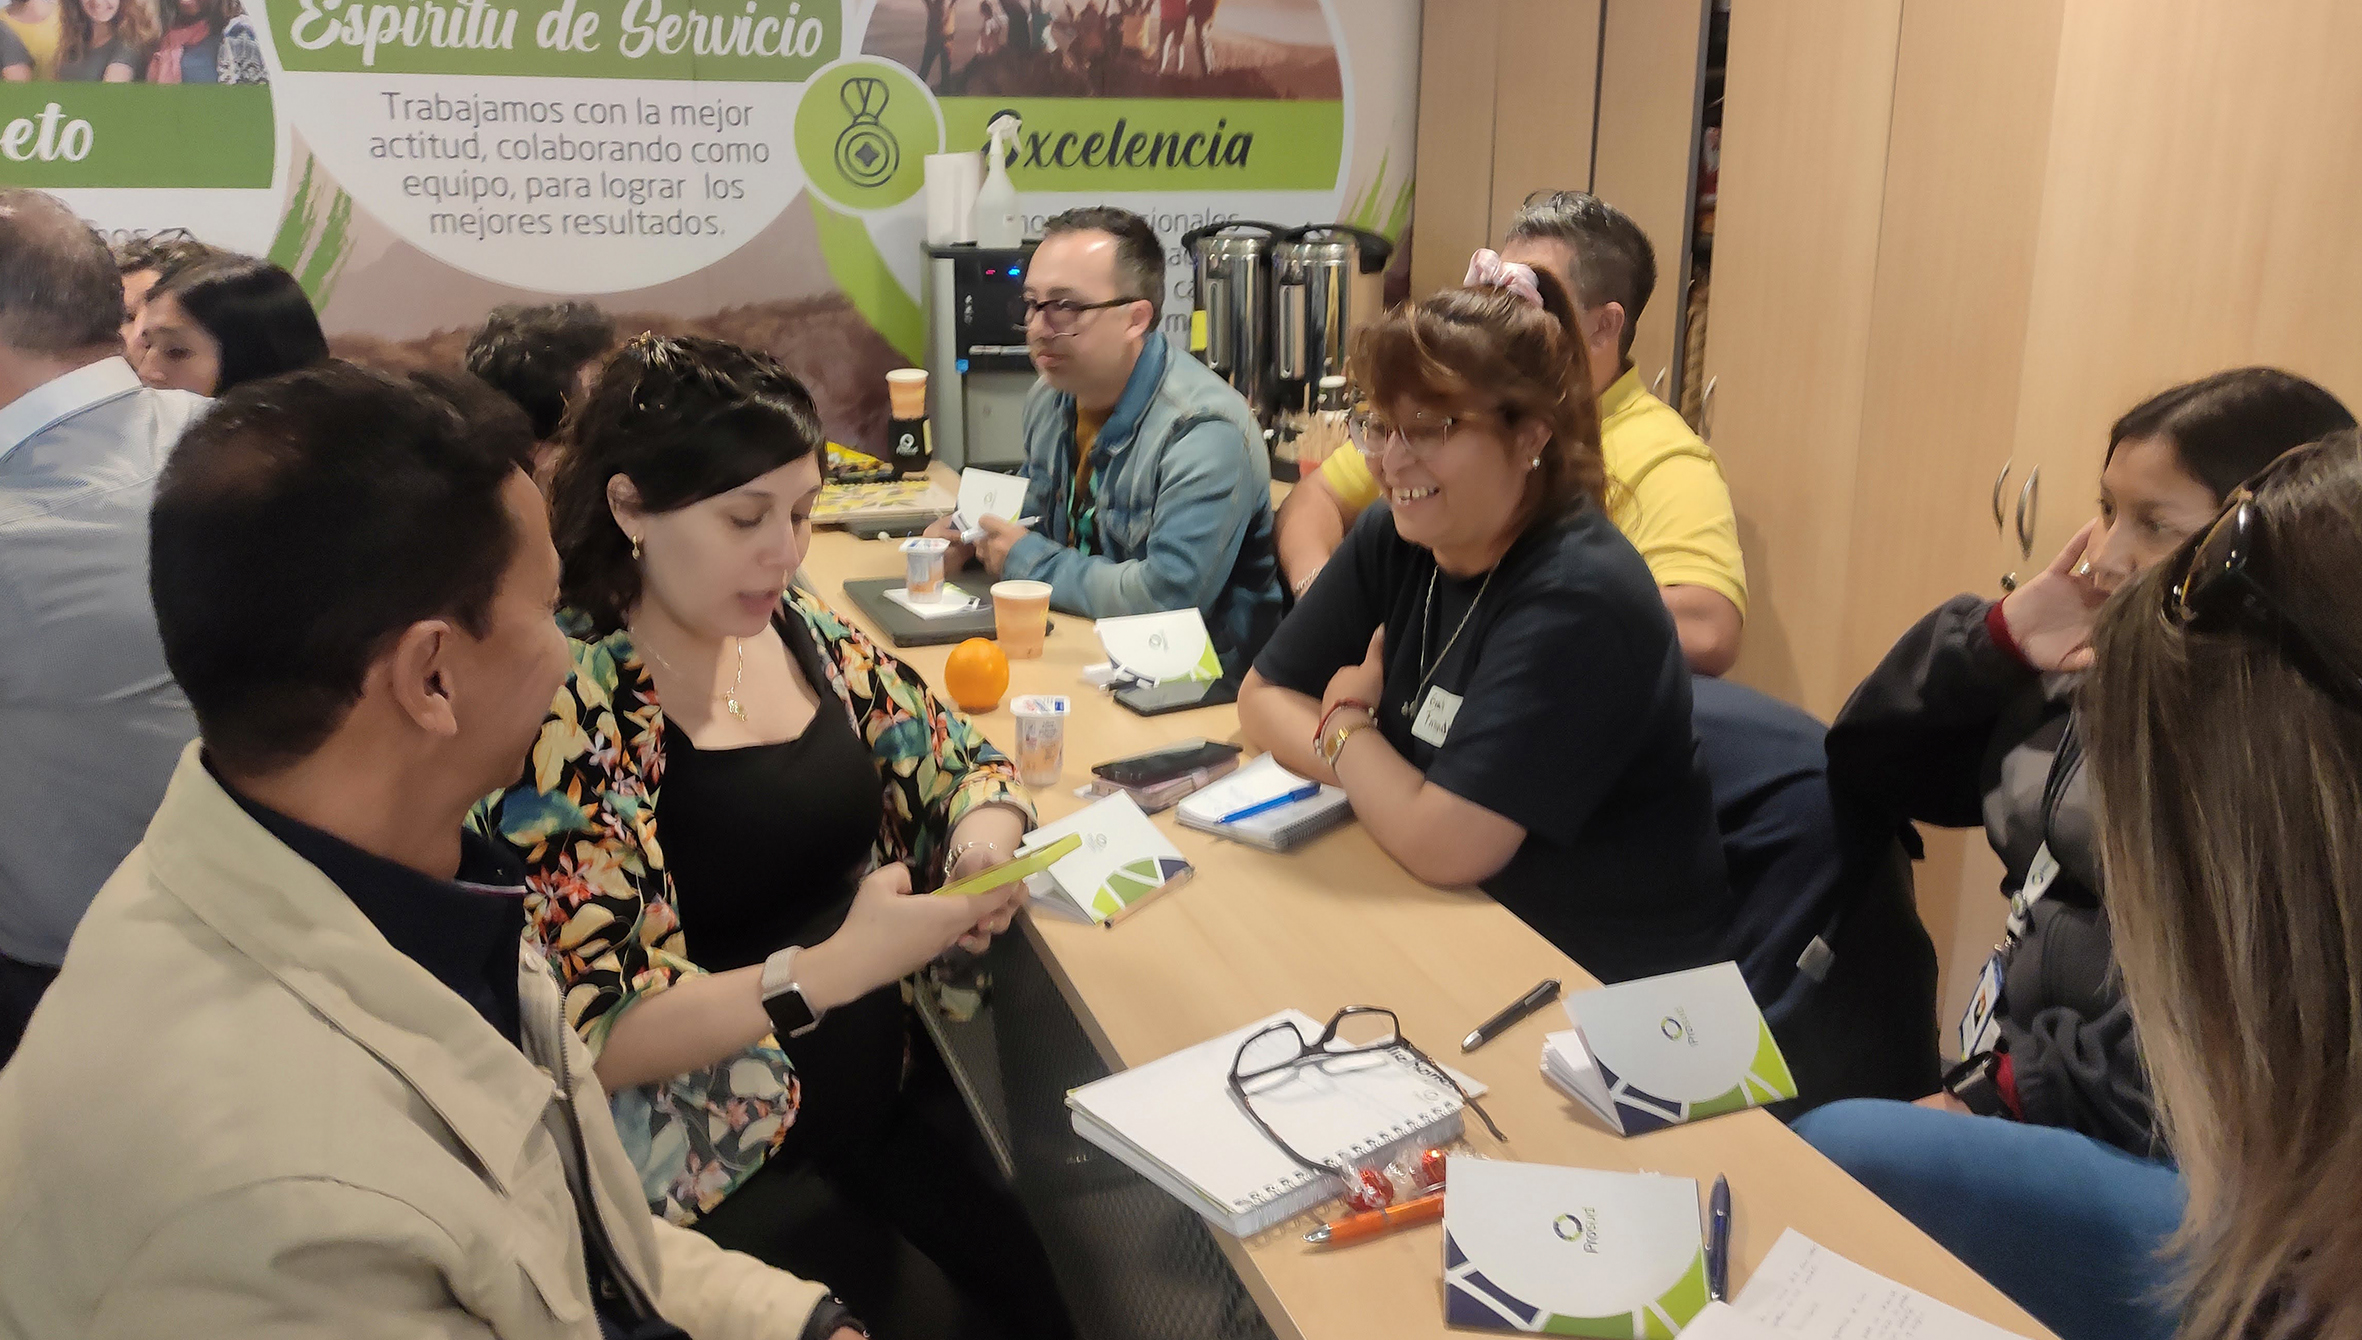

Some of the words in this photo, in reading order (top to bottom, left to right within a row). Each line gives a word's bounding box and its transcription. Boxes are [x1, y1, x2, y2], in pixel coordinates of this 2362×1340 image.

[536, 0, 600, 51] de
[619, 0, 823, 58] Servicio
[380, 91, 564, 129] Trabajamos
[573, 102, 627, 125] con
[636, 96, 660, 125] la
[671, 98, 754, 133] mejor
[369, 130, 487, 163] actitud,
[497, 132, 682, 162] colaborando
[691, 141, 770, 163] como
[402, 168, 517, 204] equipo,
[526, 176, 591, 204] para
[601, 170, 687, 206] lograr
[704, 171, 745, 200] los
[429, 207, 553, 241] mejores
[561, 207, 726, 236] resultados.
